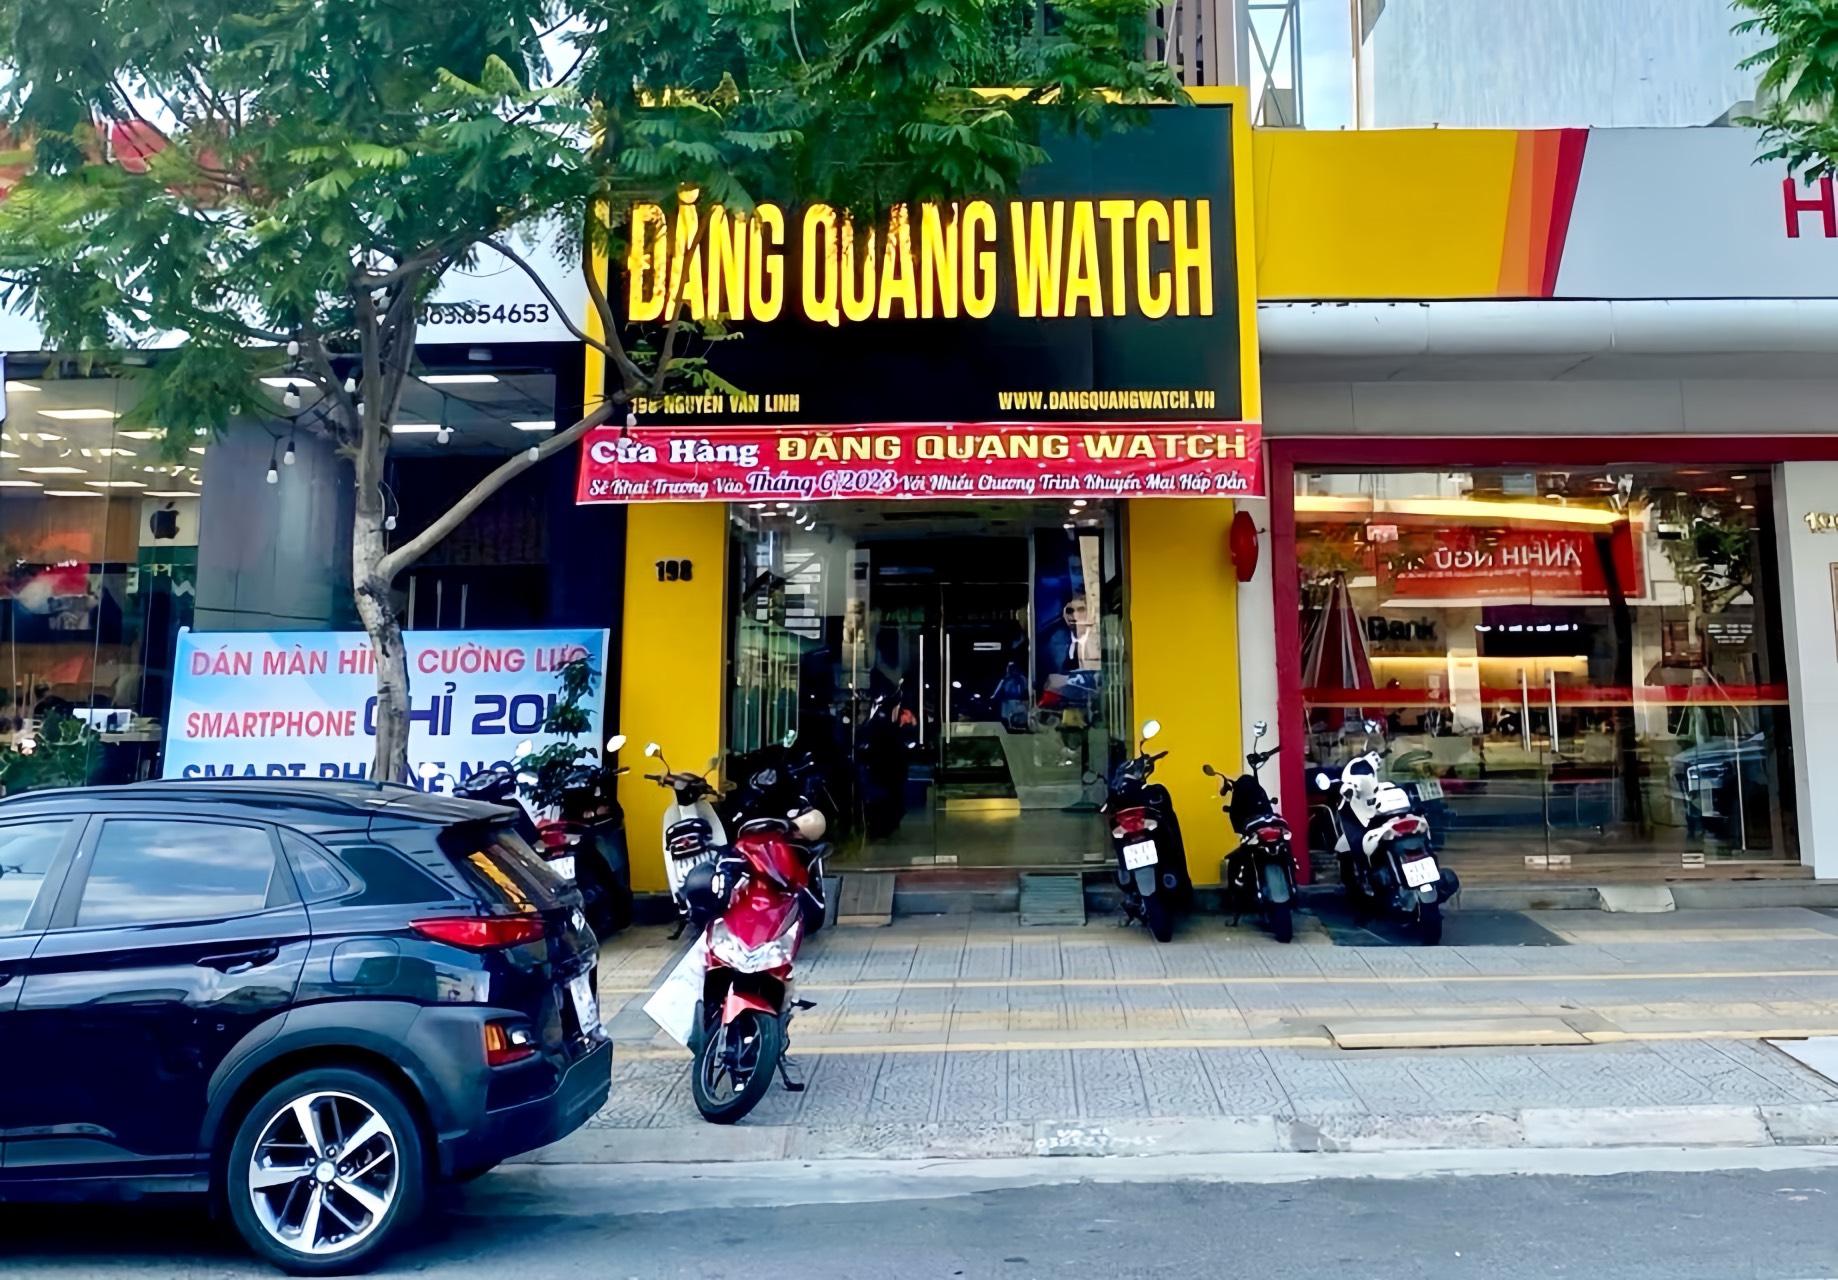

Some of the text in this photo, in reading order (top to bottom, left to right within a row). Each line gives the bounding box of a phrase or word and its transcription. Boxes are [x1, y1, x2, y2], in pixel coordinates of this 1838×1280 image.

[627, 184, 1214, 328] ĐĂNG QUANG WATCH
[765, 393, 800, 413] LINH
[998, 390, 1215, 411] WWW.DANGQUANGWATCH.VN
[669, 438, 760, 468] Hàng
[776, 431, 901, 461] ĐĂNG
[916, 434, 1070, 460] QUANG
[1083, 434, 1245, 459] WATCH
[746, 470, 817, 500] Tháng
[655, 559, 694, 582] 198
[190, 644, 253, 677] DÁN
[262, 643, 329, 675] MÀN
[417, 641, 526, 675] CƯỜNG
[186, 709, 357, 738] SMARTPHONE
